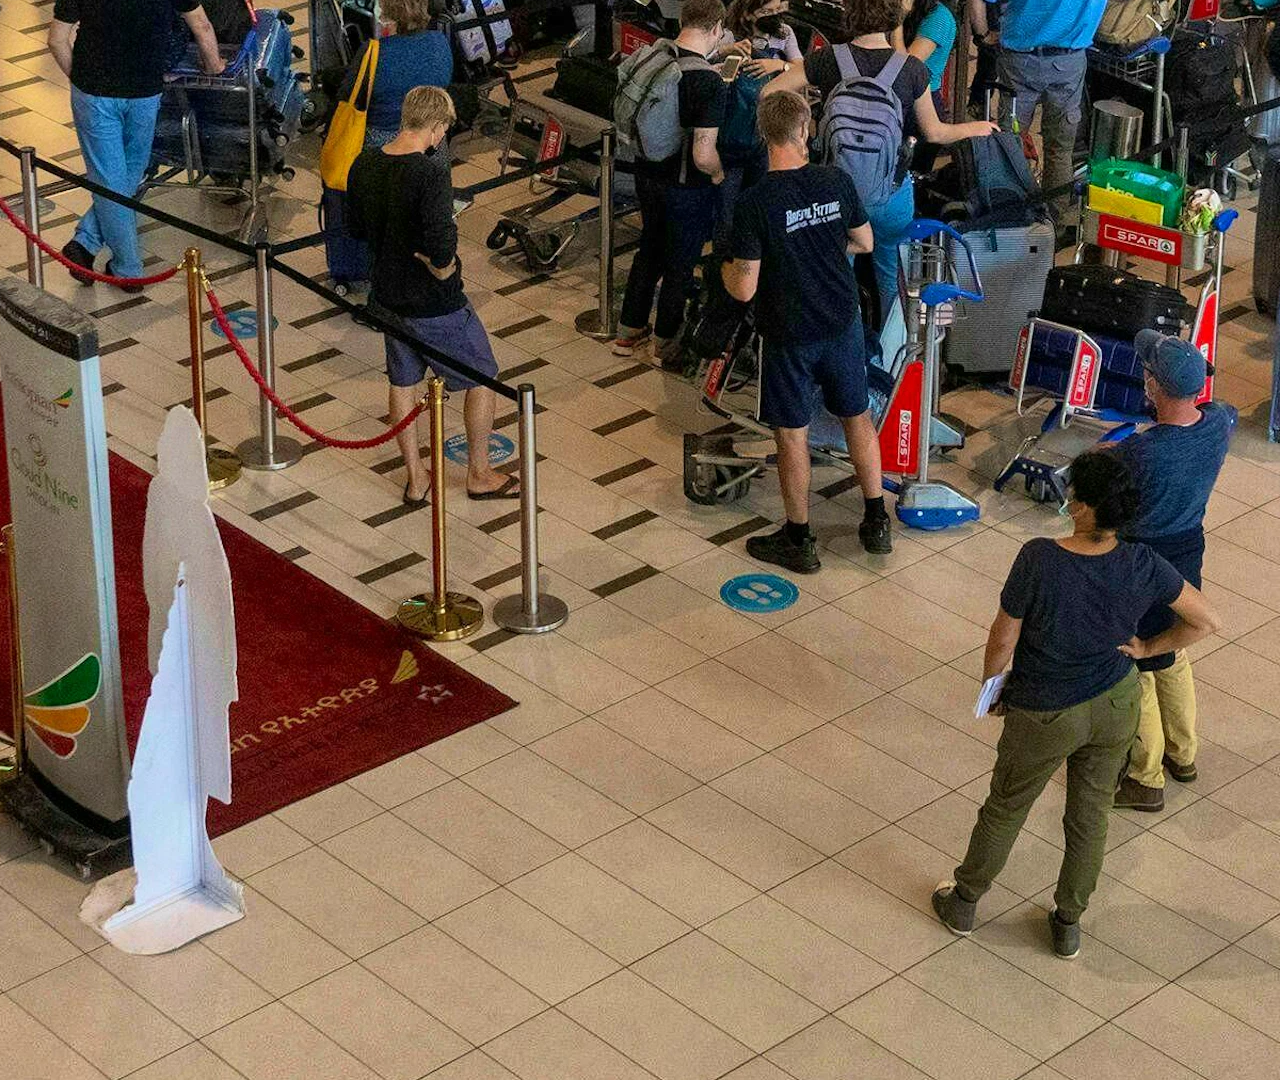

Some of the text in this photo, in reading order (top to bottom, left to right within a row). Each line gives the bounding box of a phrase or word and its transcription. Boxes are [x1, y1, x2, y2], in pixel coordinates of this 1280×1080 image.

[1116, 230, 1158, 248] SPAR
[1076, 365, 1090, 394] SPAR
[898, 423, 910, 457] SPAR
[43, 470, 79, 510] Nine
